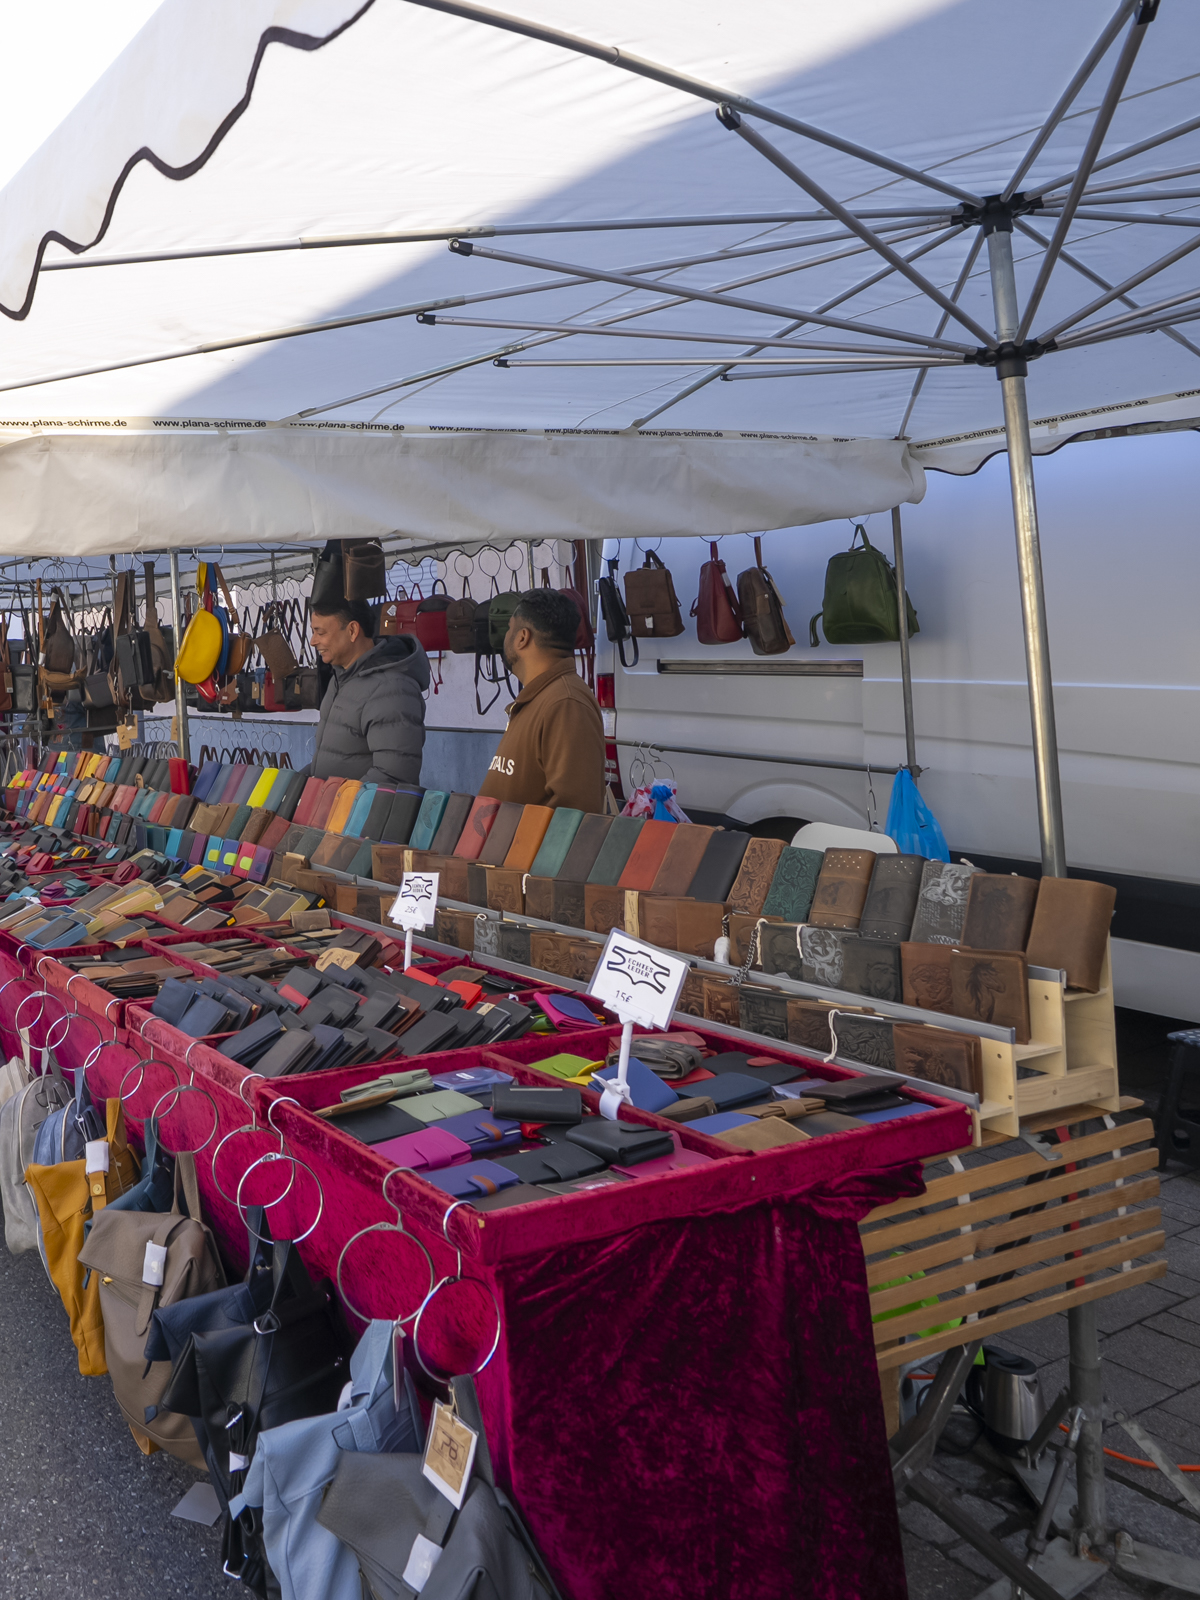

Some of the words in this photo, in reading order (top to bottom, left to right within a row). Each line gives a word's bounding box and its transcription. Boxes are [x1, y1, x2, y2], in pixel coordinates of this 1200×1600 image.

[1032, 399, 1149, 426] www.plana-schirme.de
[0, 419, 128, 428] www.plana-schirme.de
[152, 420, 267, 428] www.plana-schirme.de
[289, 421, 405, 431] www.plana-schirme.de
[915, 427, 1007, 449] www.plana-schirme.d
[404, 905, 418, 915] 25€
[627, 957, 654, 973] ECHTES
[627, 964, 650, 979] LEDER
[615, 989, 633, 1003] 15€
